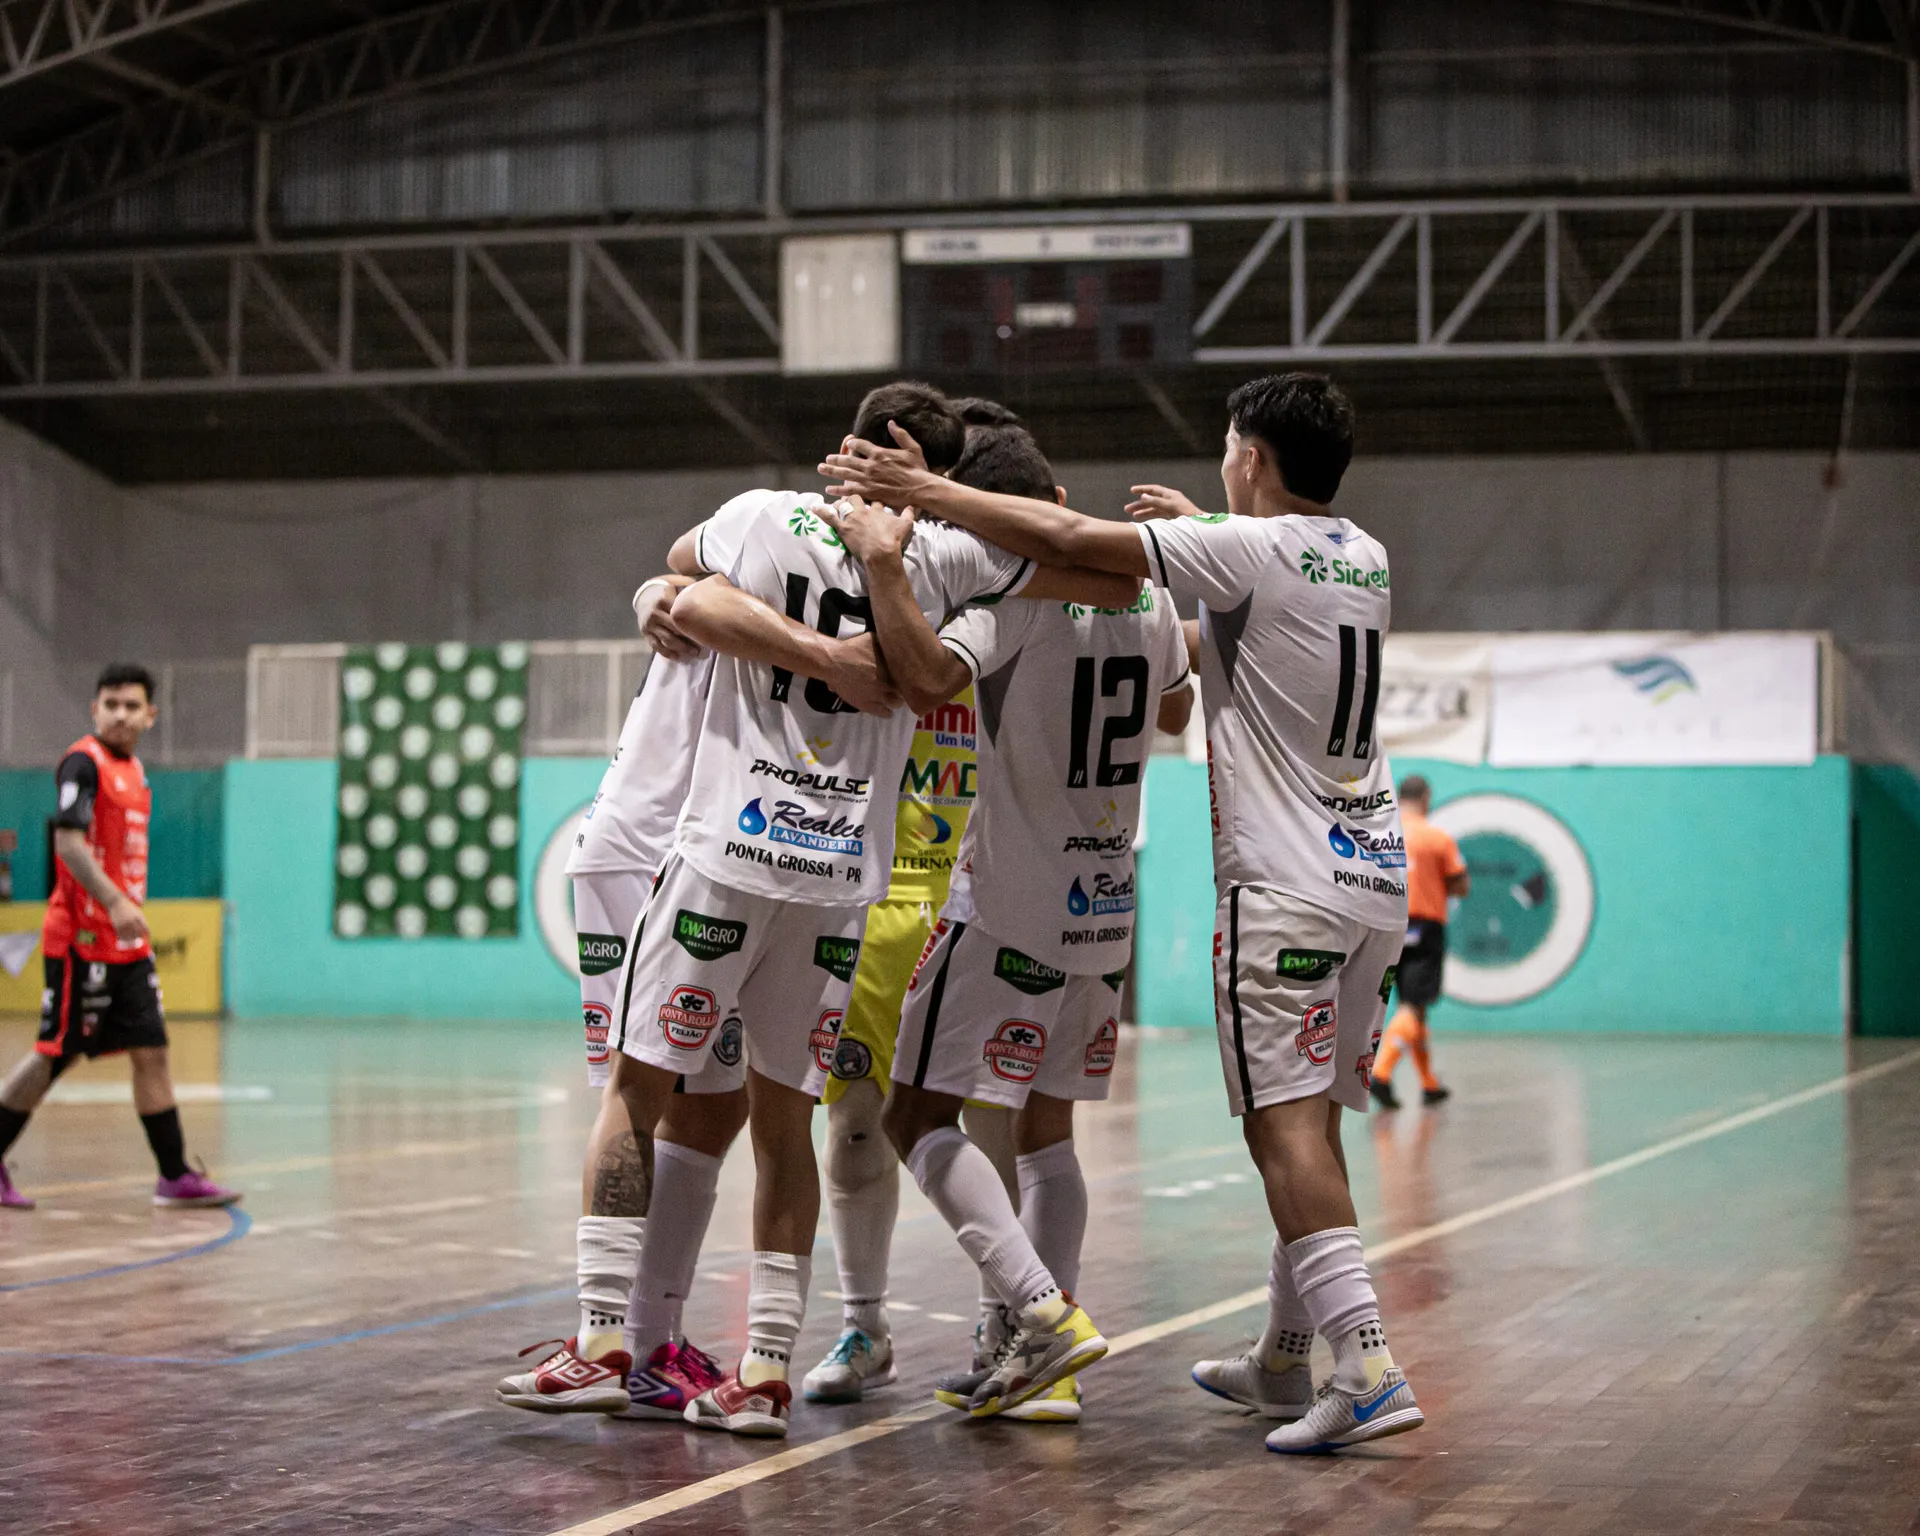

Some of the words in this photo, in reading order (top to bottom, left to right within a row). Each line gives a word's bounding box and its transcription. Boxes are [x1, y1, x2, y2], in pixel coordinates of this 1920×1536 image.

[1326, 624, 1380, 760] 11
[1066, 655, 1150, 789] 12
[935, 732, 958, 747] Um
[749, 758, 870, 796] PROPULSE
[772, 800, 865, 839] Realce
[773, 827, 860, 854] LAVANDERIA
[725, 841, 774, 867] PONTA
[776, 853, 834, 879] GROSSA
[845, 866, 862, 884] PR
[1333, 870, 1370, 891] PONTA
[1062, 930, 1096, 946] PONTA
[659, 1007, 719, 1026] PONTAROLLO
[671, 1026, 703, 1039] FEIJÃO
[1000, 1060, 1034, 1073] FEIJÃO
